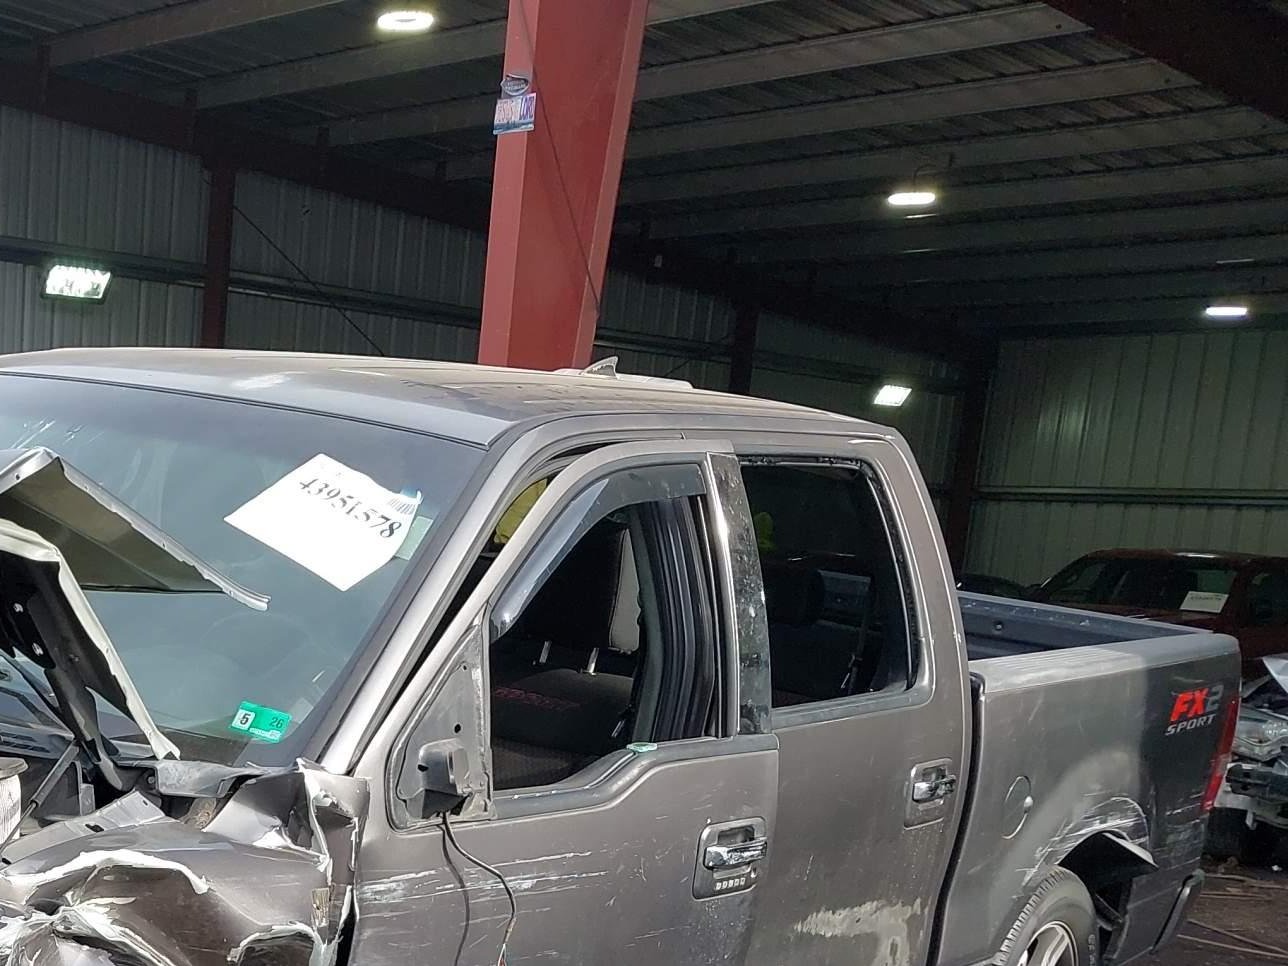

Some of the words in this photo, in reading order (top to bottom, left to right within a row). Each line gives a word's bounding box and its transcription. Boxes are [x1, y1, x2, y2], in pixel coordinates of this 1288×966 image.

[299, 478, 402, 538] 43951578
[1170, 685, 1224, 721] FX2
[240, 713, 251, 725] 5
[269, 717, 285, 729] 26
[1165, 714, 1216, 736] SPORT
